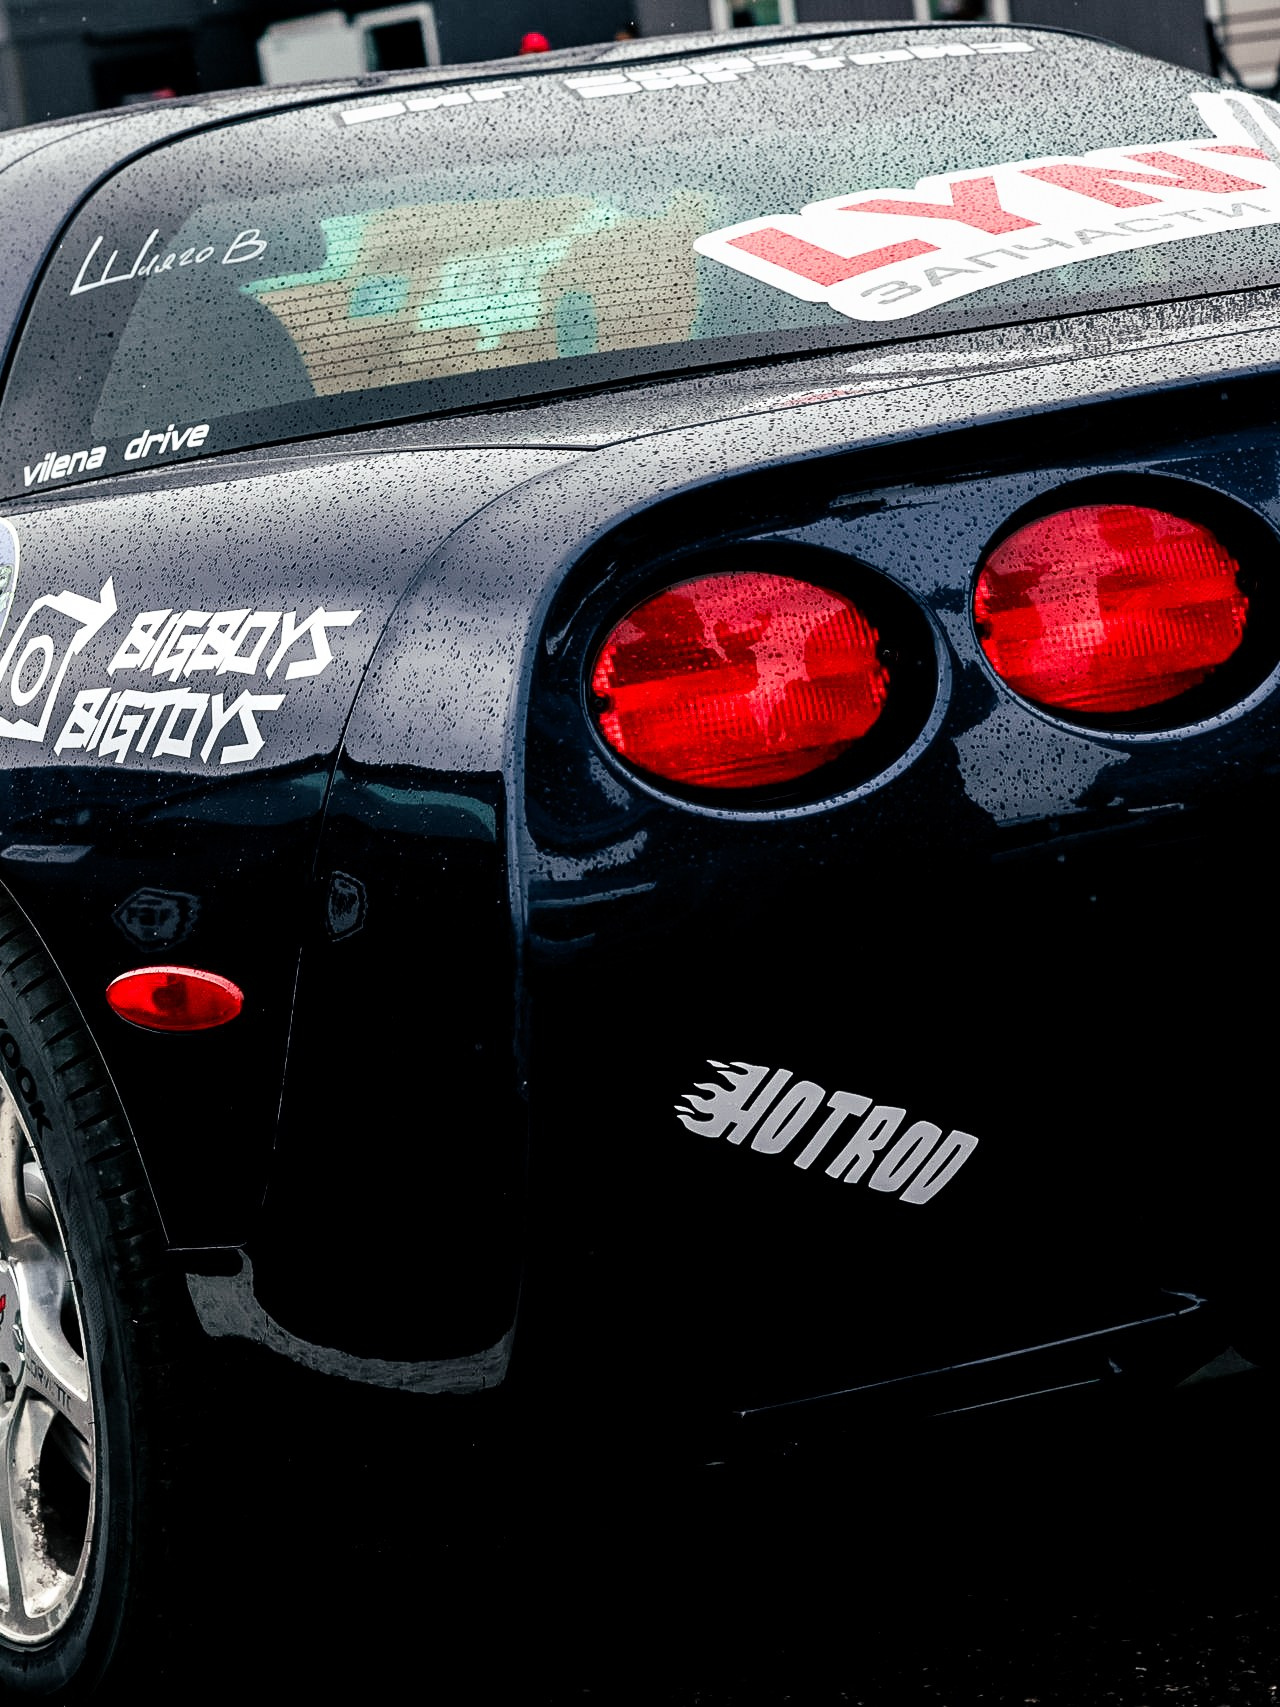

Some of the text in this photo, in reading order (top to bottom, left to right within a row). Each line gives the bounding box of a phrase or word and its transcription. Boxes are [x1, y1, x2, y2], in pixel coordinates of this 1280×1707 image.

[859, 200, 1272, 306] ЗАПЧАСТИ
[23, 423, 211, 488] vilena drive
